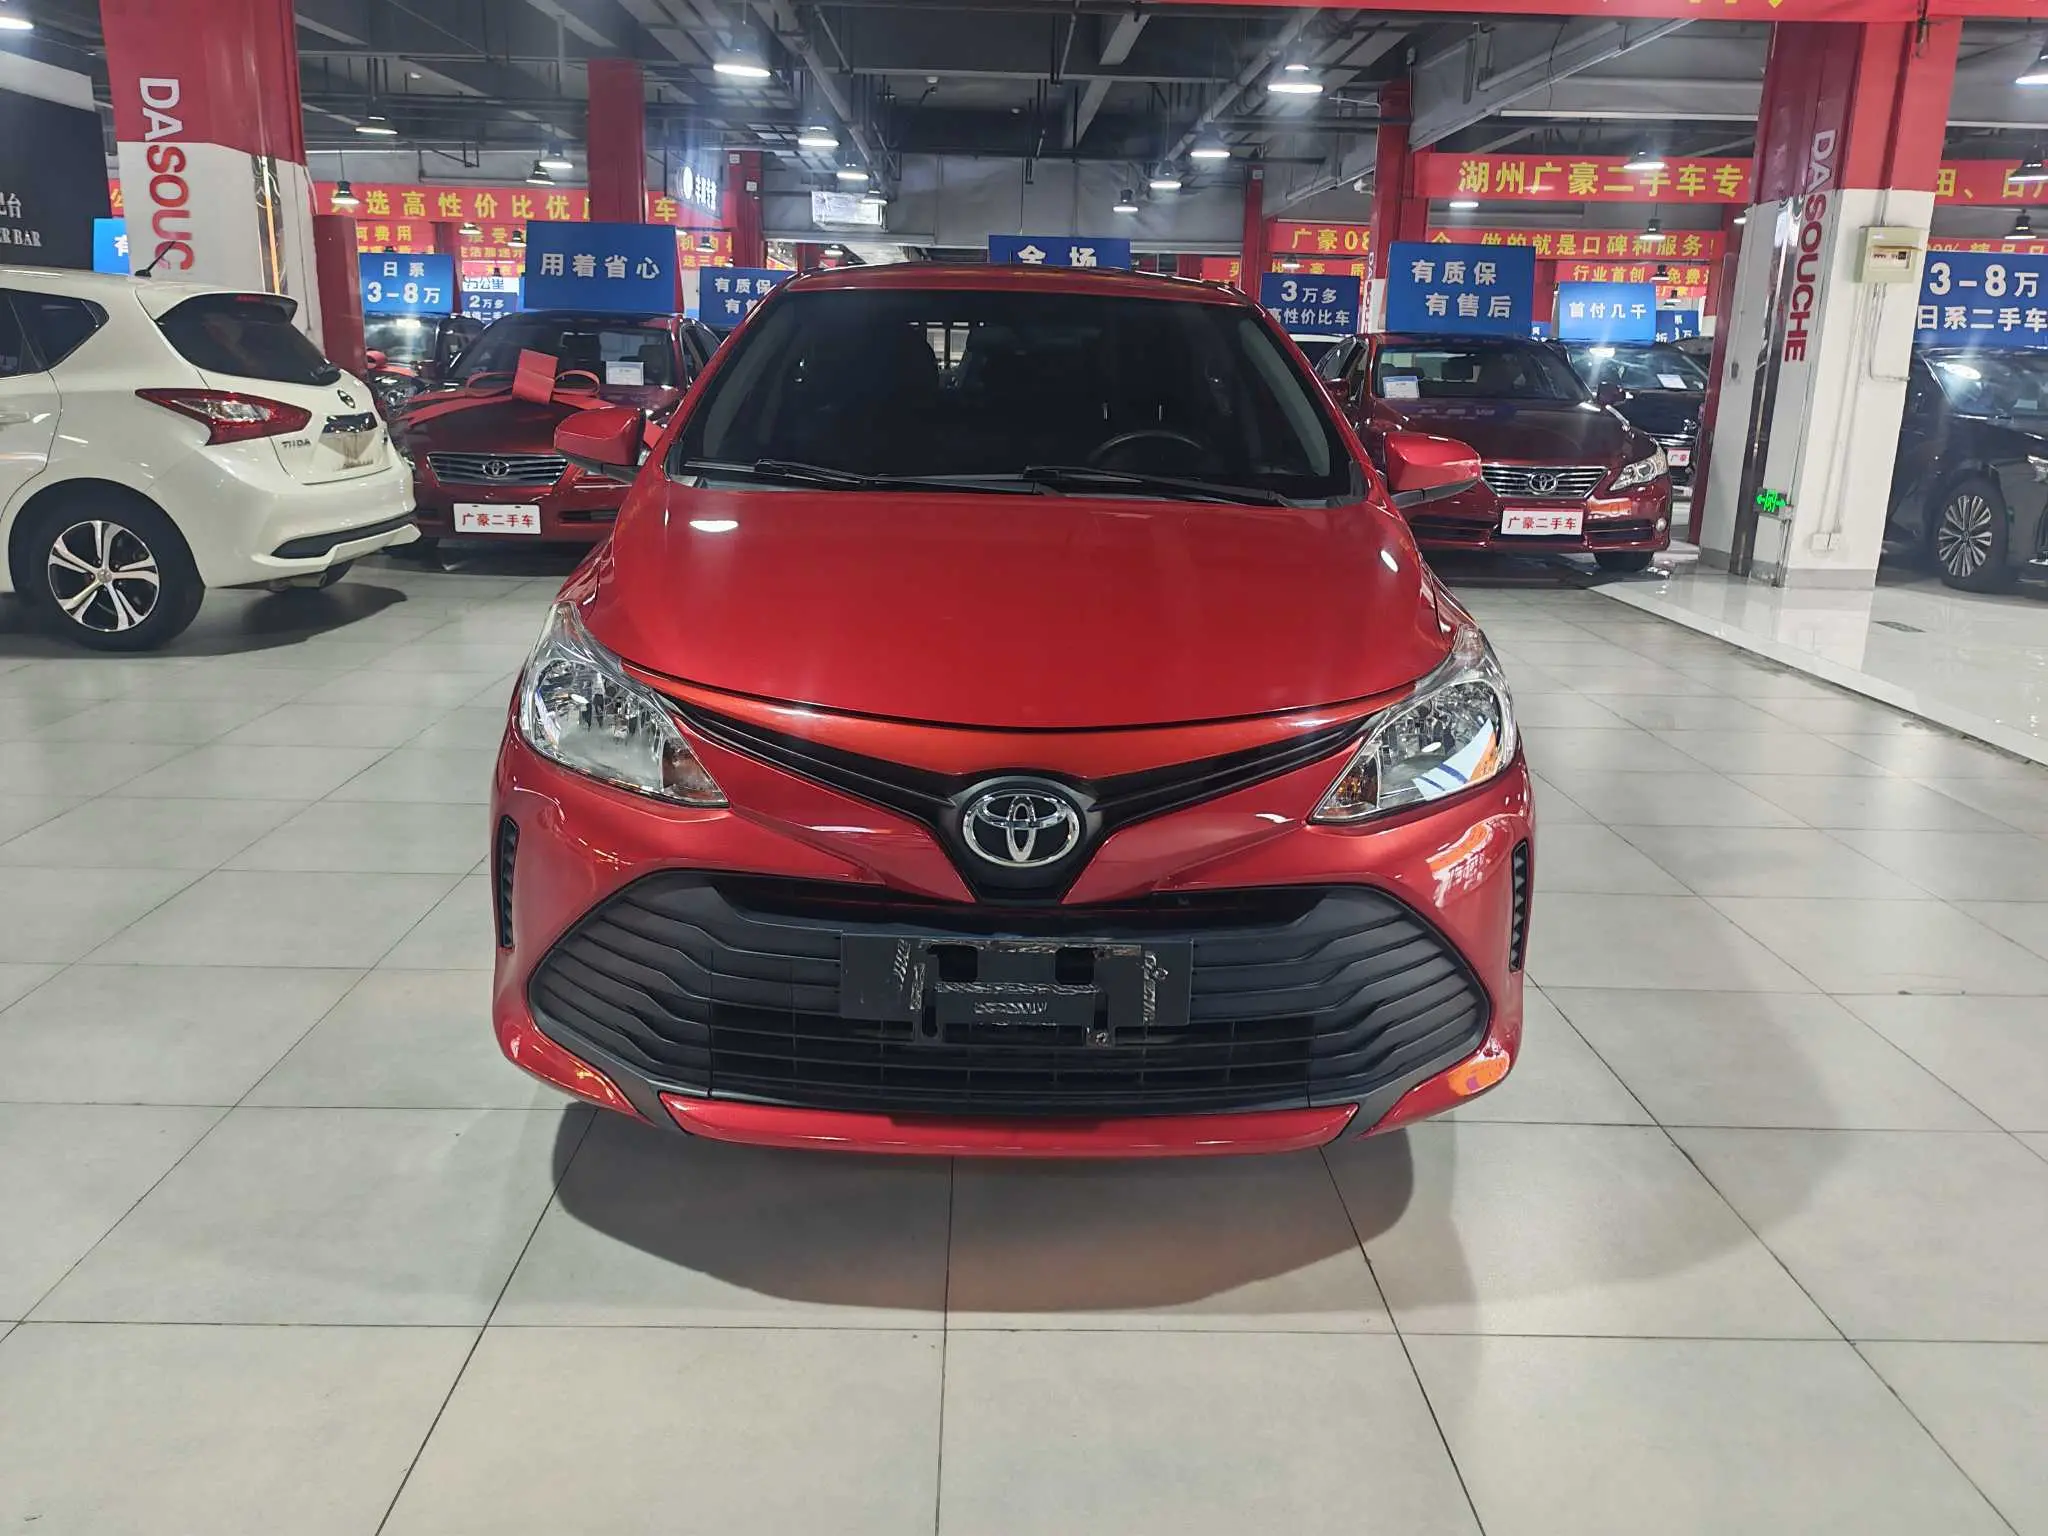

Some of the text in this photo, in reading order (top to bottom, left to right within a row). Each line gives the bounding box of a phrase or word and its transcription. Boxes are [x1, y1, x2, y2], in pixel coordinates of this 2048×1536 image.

[1458, 160, 1743, 197] 湖州广豪二手车专
[654, 197, 677, 222] 车
[12, 229, 42, 247] BAR
[1784, 129, 1838, 362] DASOUCHE
[383, 261, 425, 277] 日系
[540, 253, 660, 279] 用着省心
[1411, 259, 1497, 285] 有质保
[714, 278, 772, 294] 有质保
[1281, 281, 1337, 304] 3万多
[1425, 293, 1512, 318] 有售后
[1569, 302, 1647, 320] 首付几千
[1268, 308, 1350, 326] 高性价比车
[1916, 304, 2048, 333] 日系二手车
[281, 438, 311, 449] TIIDA
[462, 513, 535, 528] 广豪二手车
[1507, 516, 1577, 530] 广豪二手车
